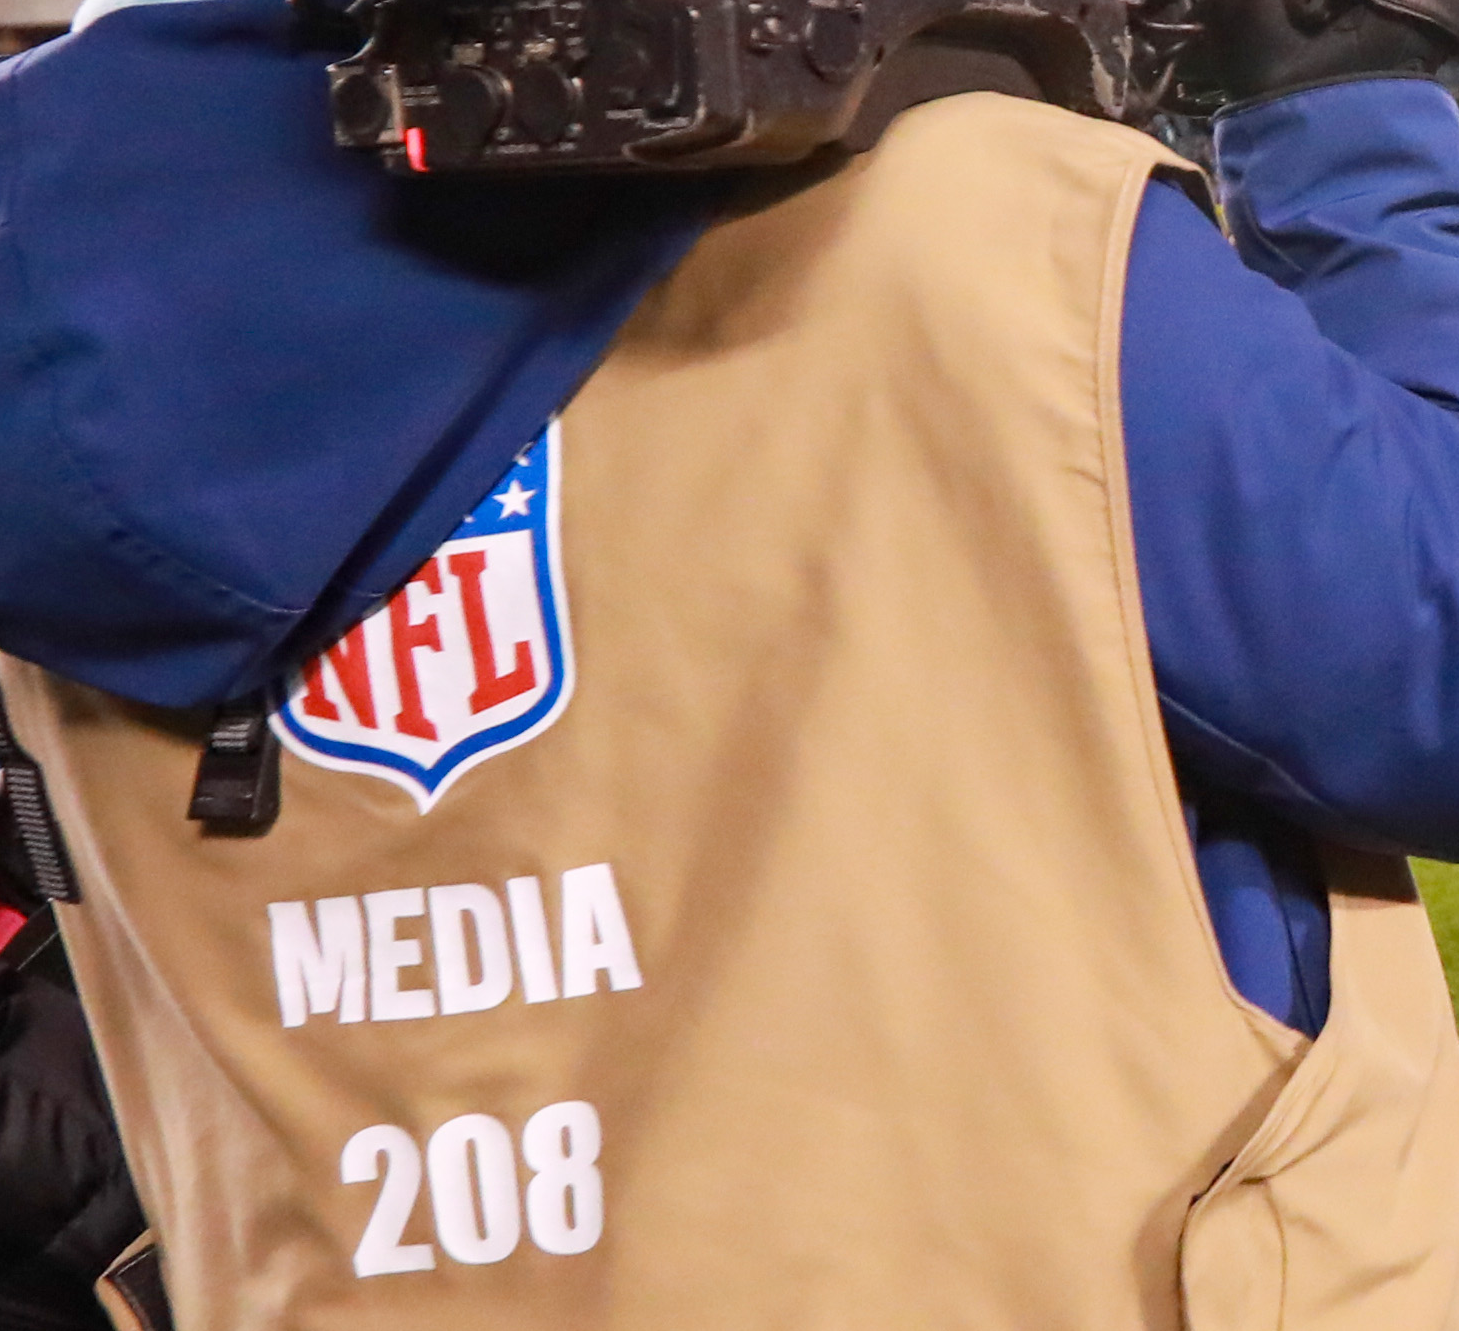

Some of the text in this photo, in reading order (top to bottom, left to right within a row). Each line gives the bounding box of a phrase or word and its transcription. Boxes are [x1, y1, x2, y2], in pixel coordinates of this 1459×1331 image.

[298, 549, 537, 743] NFL
[266, 862, 643, 1028] MEDIA
[339, 1100, 604, 1279] 208
